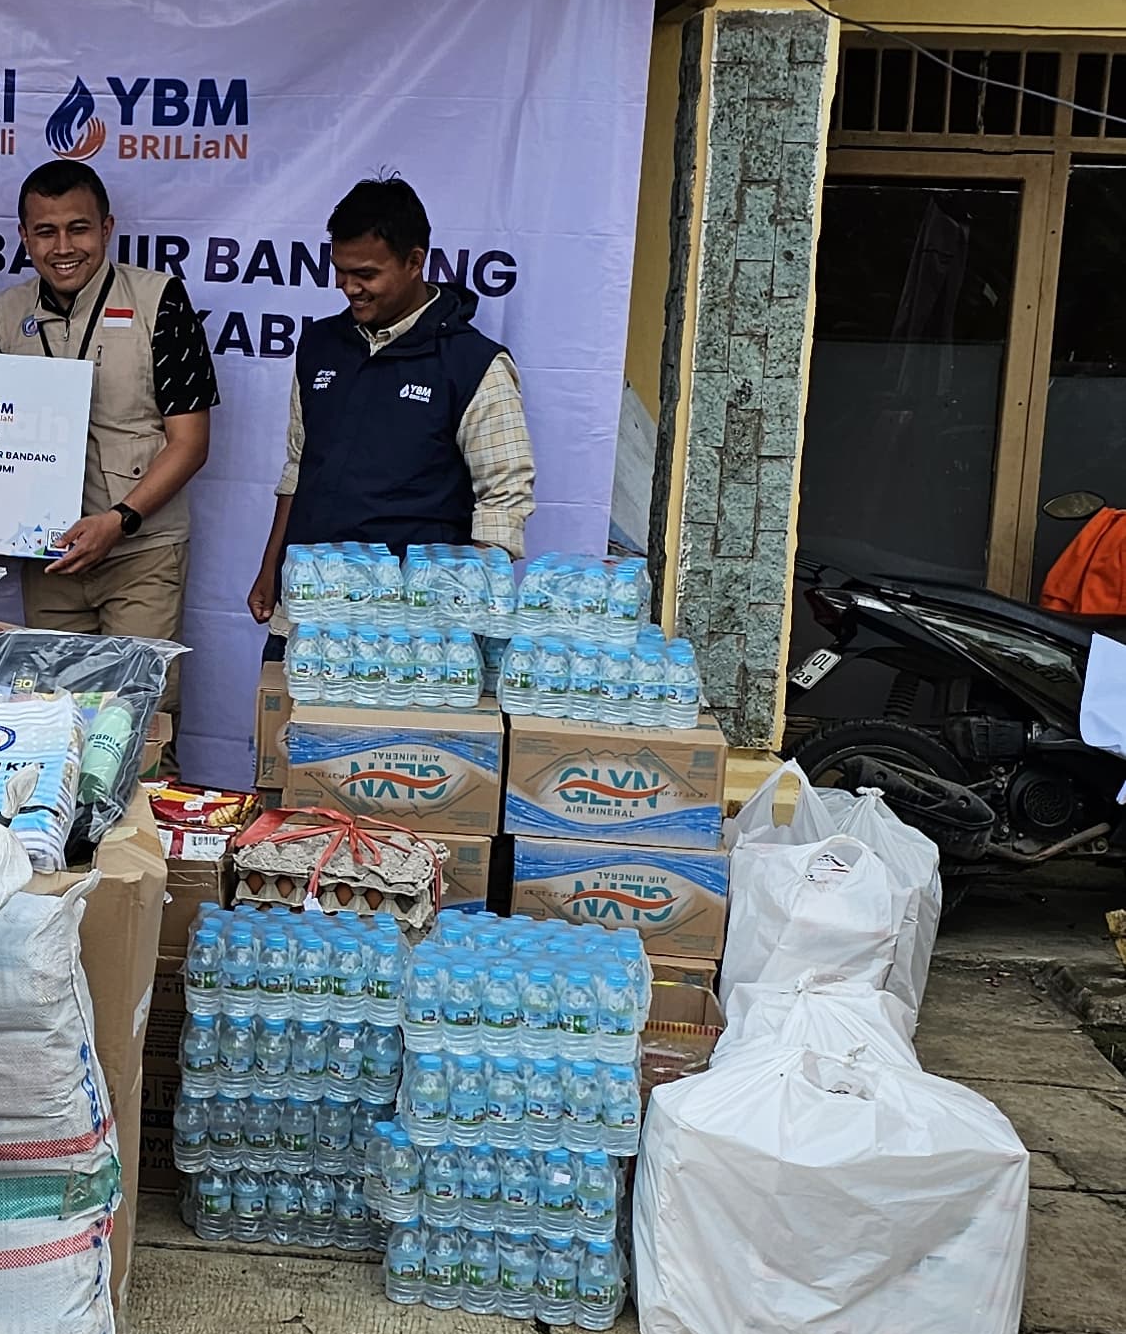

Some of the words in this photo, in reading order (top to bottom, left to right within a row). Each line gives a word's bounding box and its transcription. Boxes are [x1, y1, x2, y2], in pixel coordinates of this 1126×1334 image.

[106, 76, 249, 127] YBM
[118, 133, 248, 160] BRILiaN
[204, 236, 518, 298] BANNG
[410, 384, 432, 397] YBM
[6, 451, 56, 463] BANDANG
[371, 751, 418, 761] MINERAL
[421, 753, 441, 762] AIR
[348, 760, 447, 800] GLYN
[558, 766, 660, 809] GLYN
[564, 805, 584, 814] AIR
[587, 807, 635, 818] MINERAL
[596, 871, 644, 883] MINERAL
[649, 876, 667, 885] AIR
[574, 880, 673, 923] GLYN
